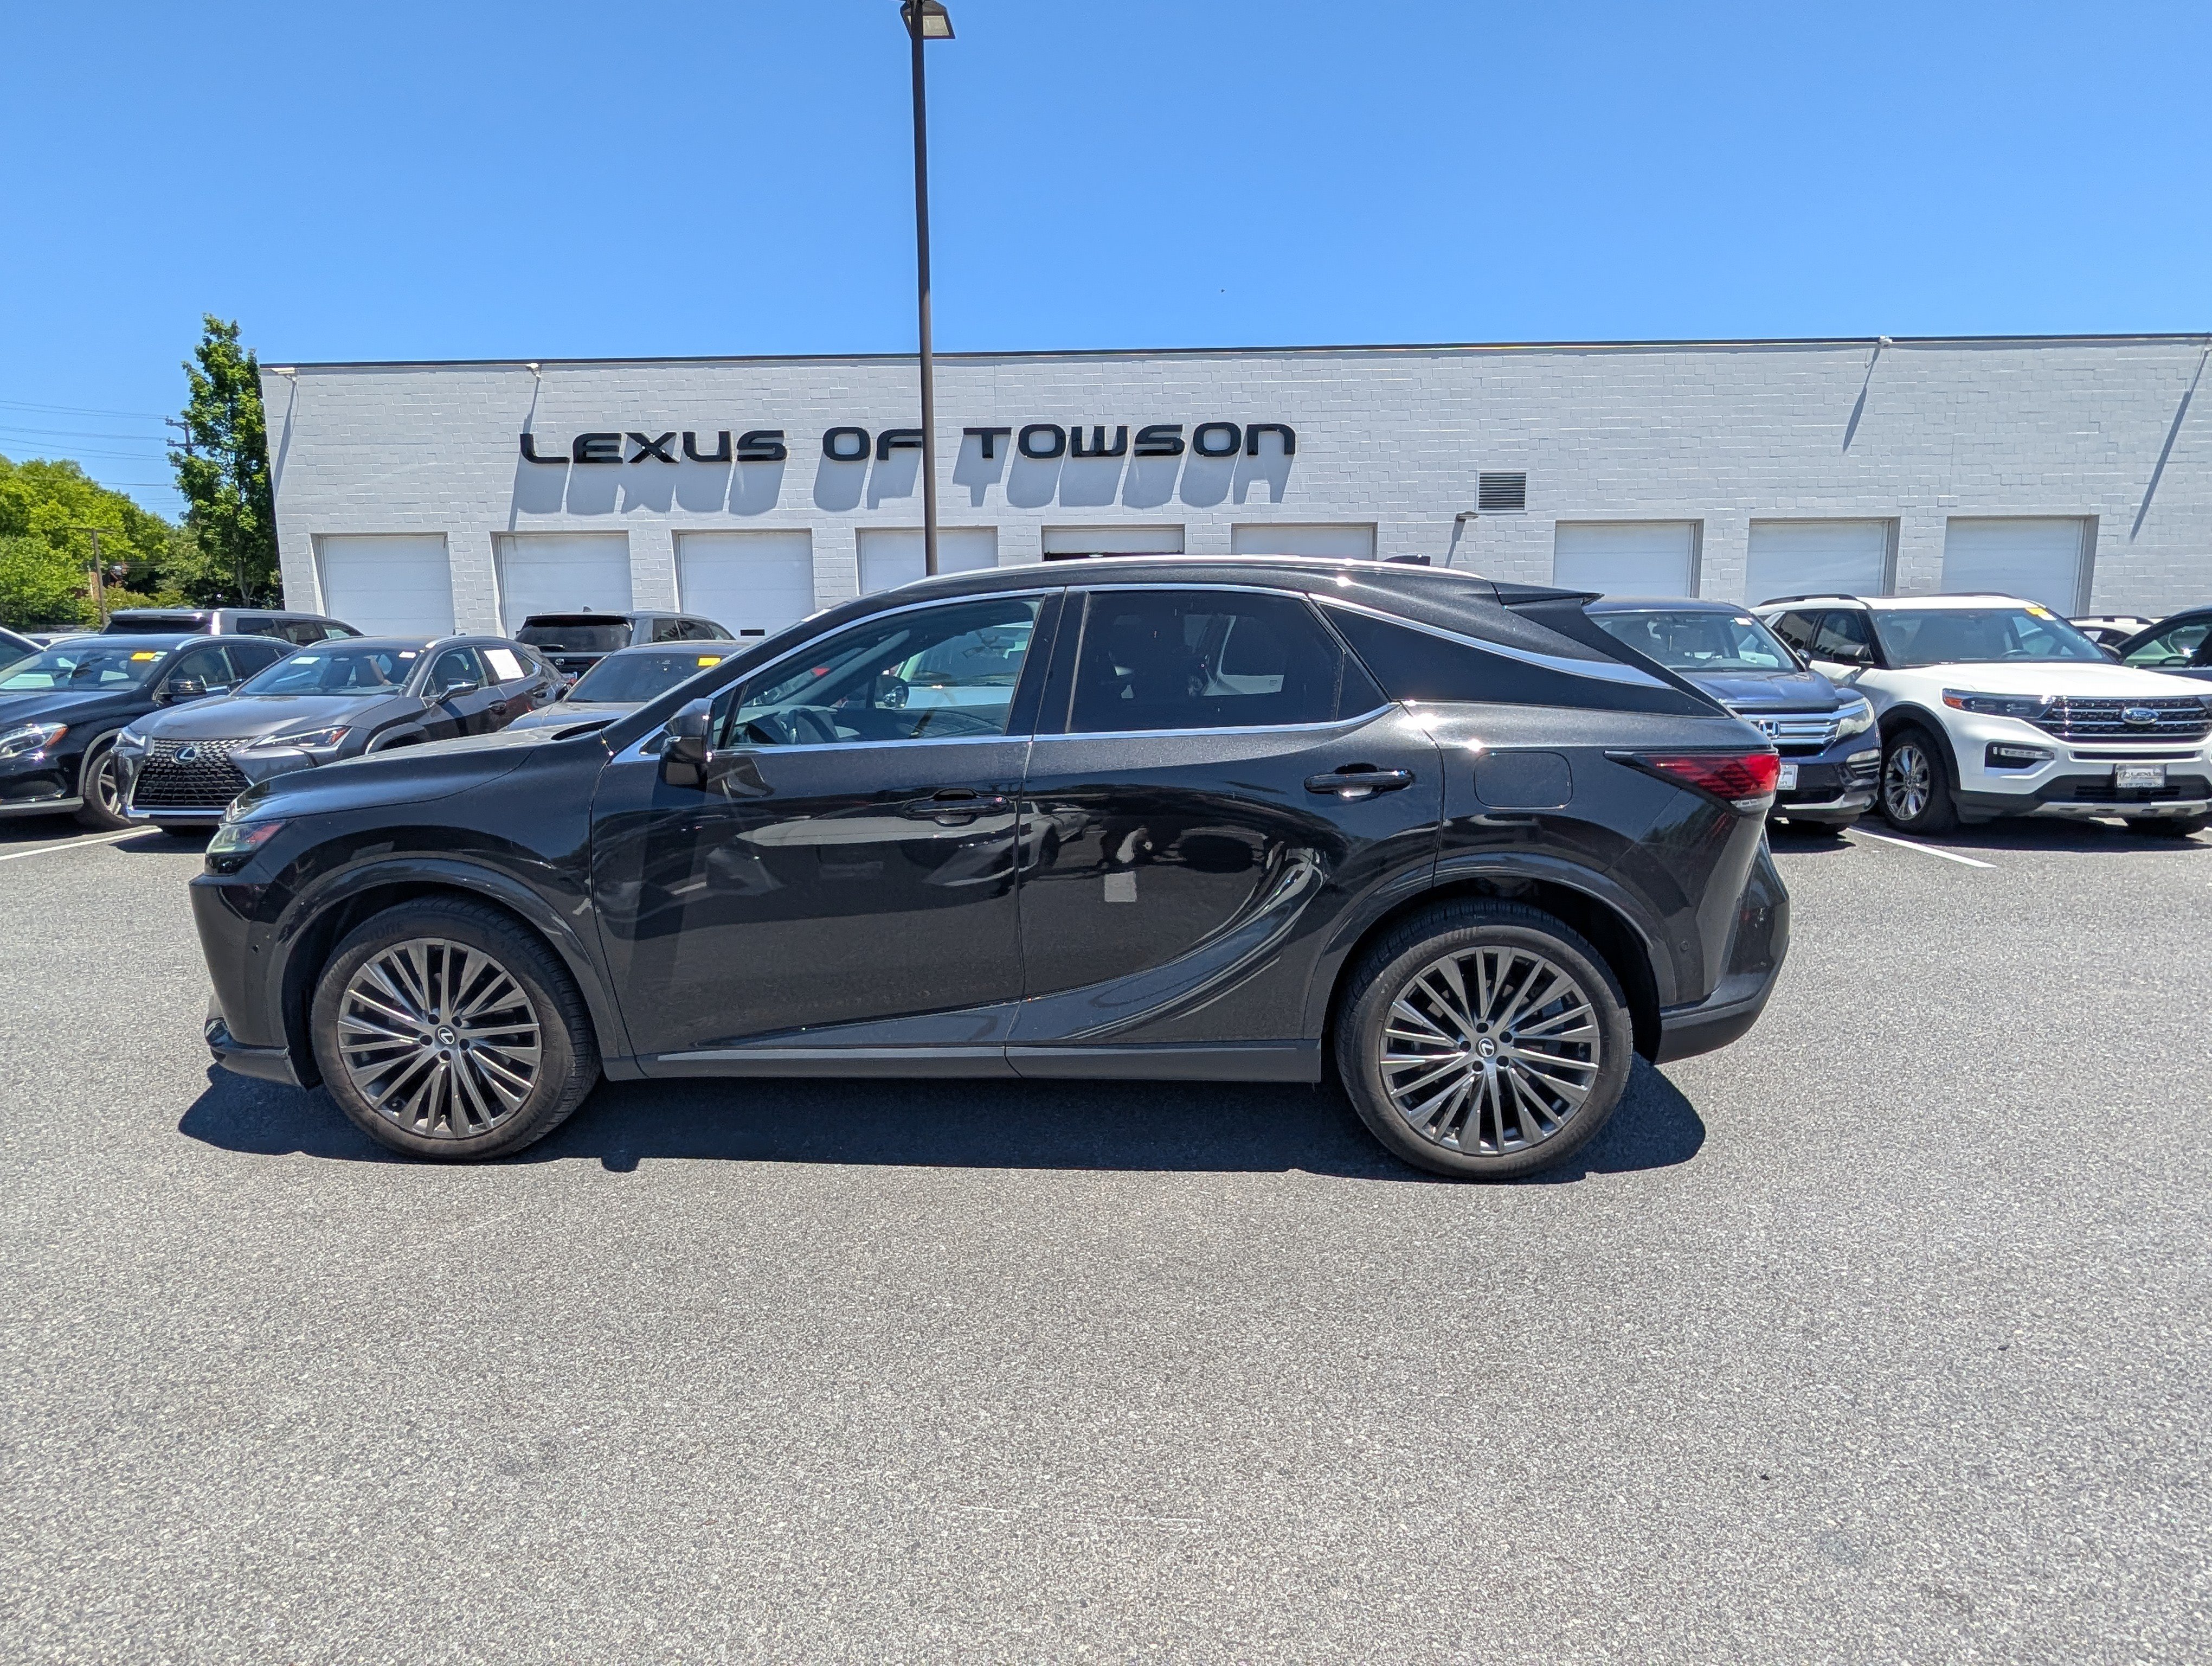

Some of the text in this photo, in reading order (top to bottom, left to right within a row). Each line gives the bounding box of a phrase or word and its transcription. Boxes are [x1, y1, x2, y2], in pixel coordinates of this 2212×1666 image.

[519, 422, 1296, 464] LEXUS OF TOWSON
